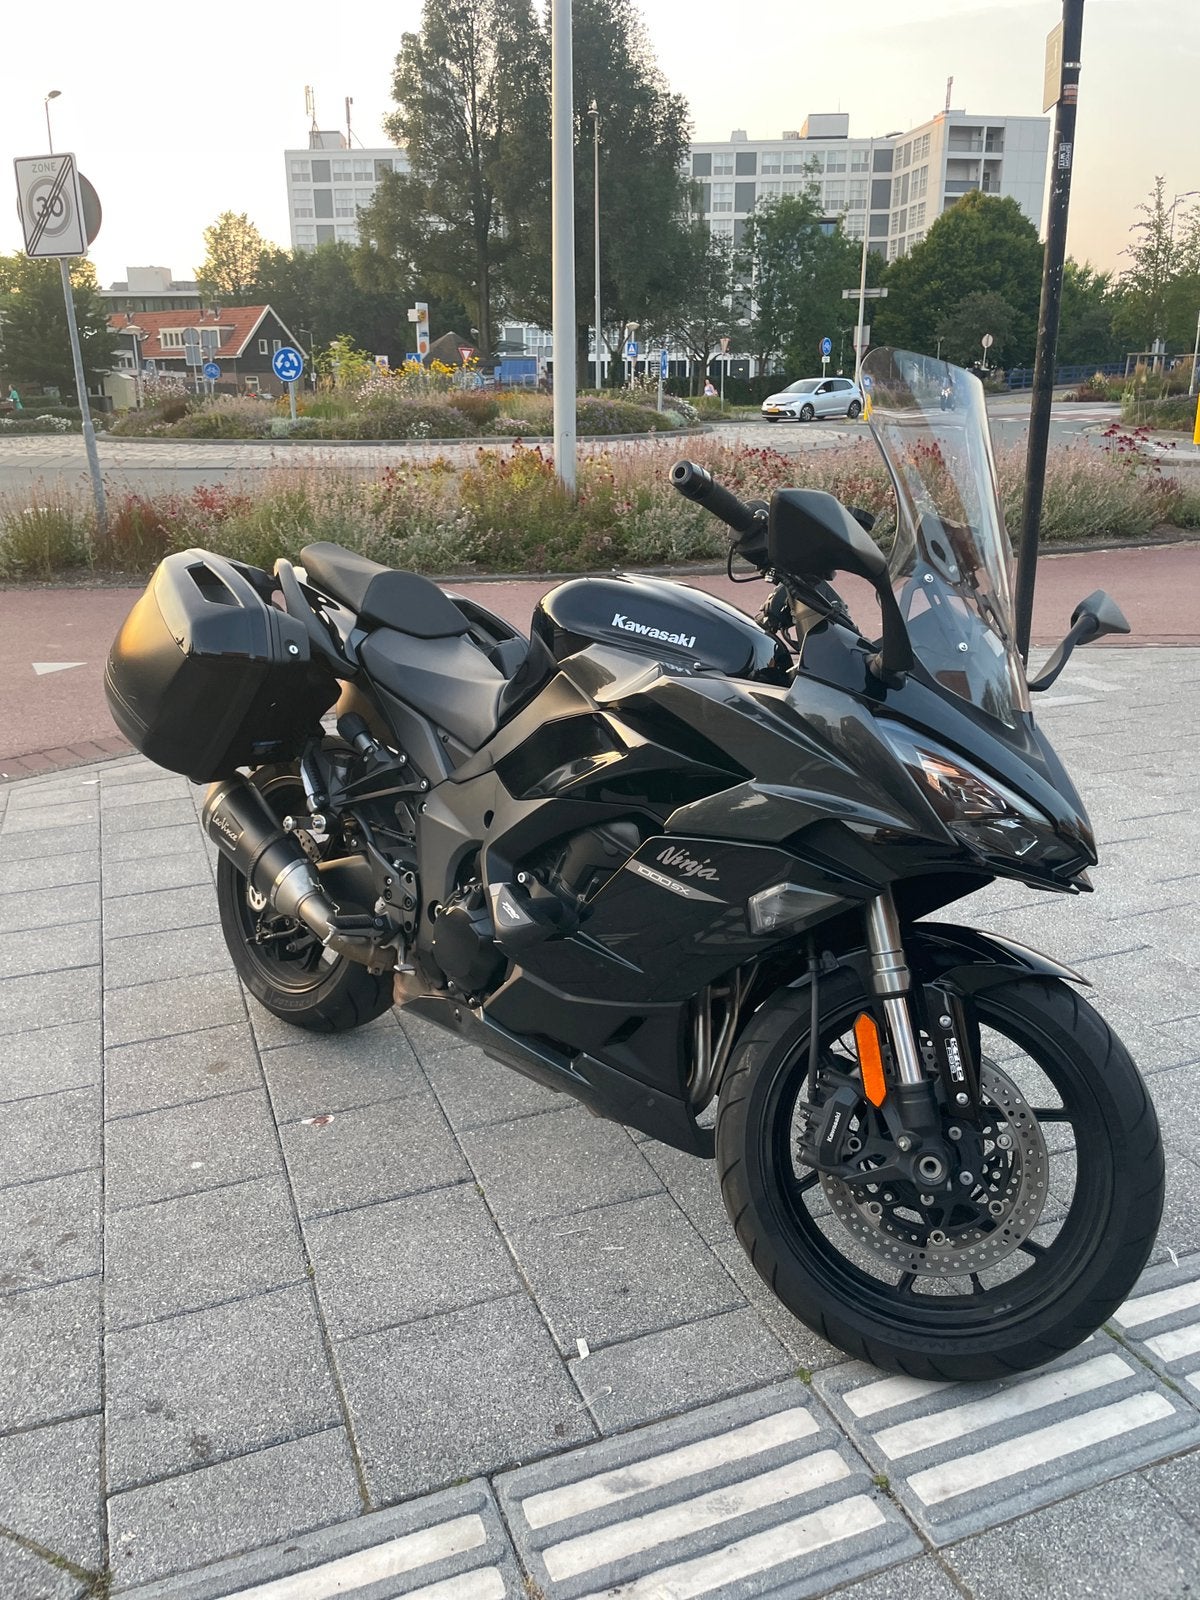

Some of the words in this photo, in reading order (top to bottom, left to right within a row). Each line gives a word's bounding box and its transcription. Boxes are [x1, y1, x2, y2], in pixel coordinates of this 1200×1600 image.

[31, 162, 58, 174] ZONE
[36, 196, 64, 218] 30
[611, 613, 697, 649] Kawasaki
[656, 846, 720, 881] Ninja
[637, 865, 691, 896] 1000SX
[826, 1111, 842, 1143] Kawasaki
